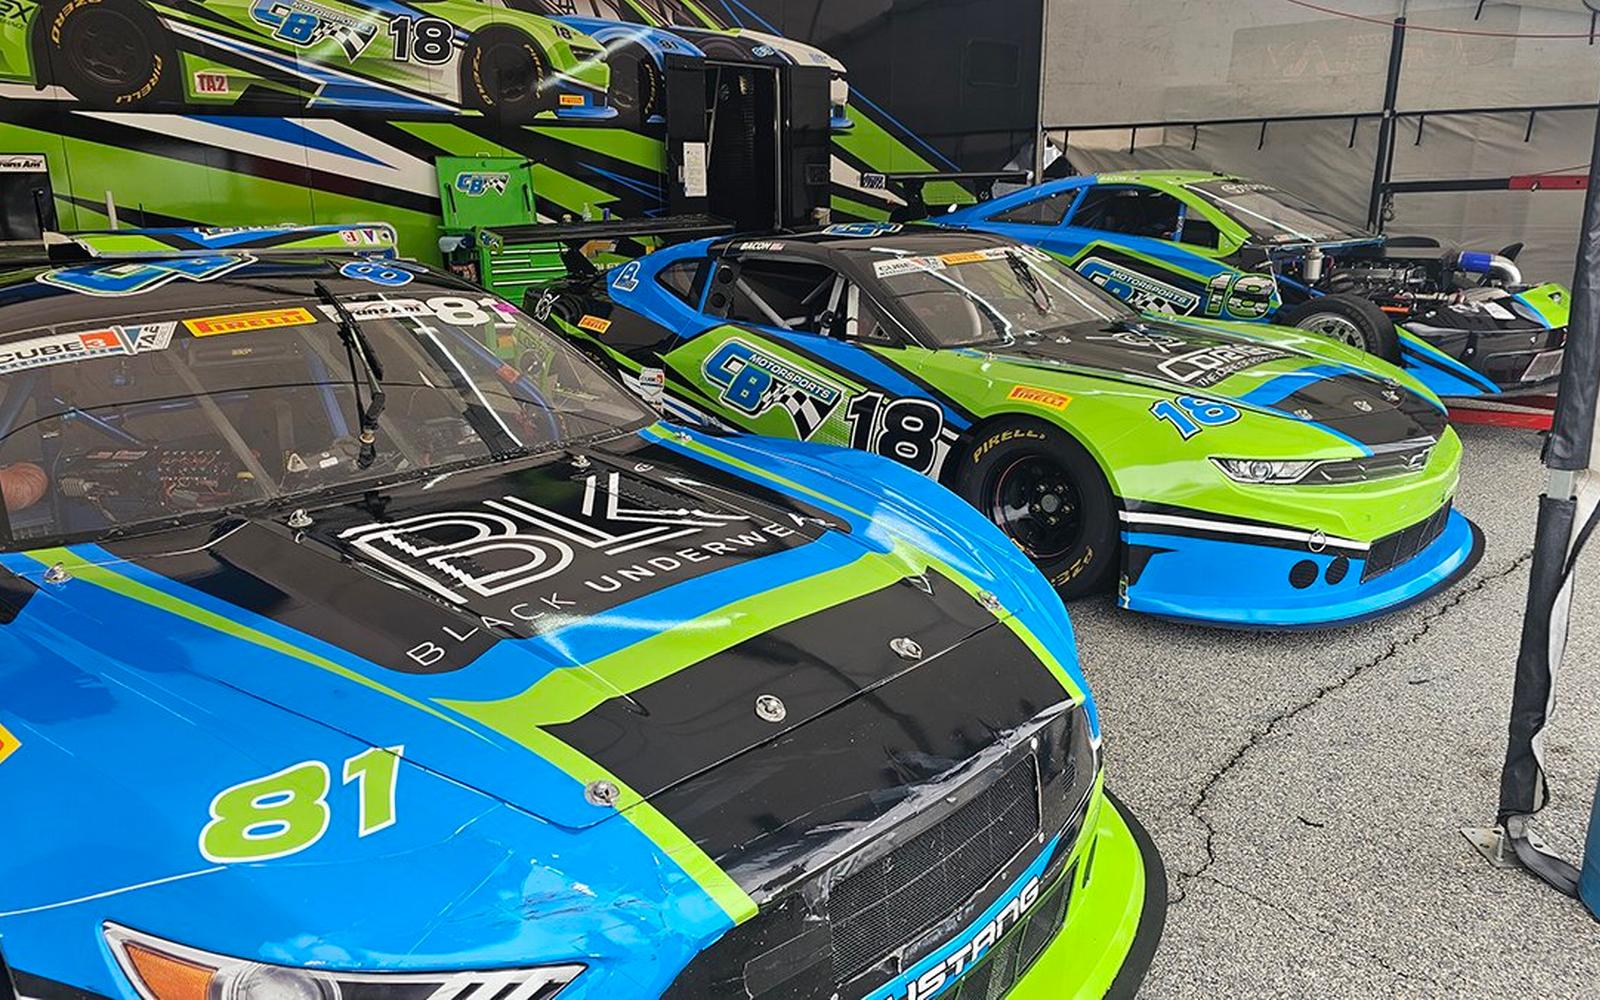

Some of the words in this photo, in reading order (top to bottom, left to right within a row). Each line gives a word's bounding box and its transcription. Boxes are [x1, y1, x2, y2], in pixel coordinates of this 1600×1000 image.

[389, 14, 455, 65] 18
[552, 25, 573, 40] 18
[116, 54, 162, 103] PIRELLI
[197, 73, 226, 91] TA2
[740, 242, 770, 250] BACON
[1110, 271, 1188, 304] MOTORSPORTS
[1205, 271, 1278, 320] 18
[194, 310, 305, 333] PIRELLI
[426, 297, 517, 326] 81
[703, 339, 774, 413] CB
[750, 352, 832, 399] MOTORSPORTS
[1011, 387, 1068, 407] PIRELLI
[846, 390, 945, 477] 18
[1149, 394, 1242, 440] 18
[972, 429, 1046, 463] PIRELLI
[406, 591, 577, 666] BLACK
[198, 745, 405, 864] 81
